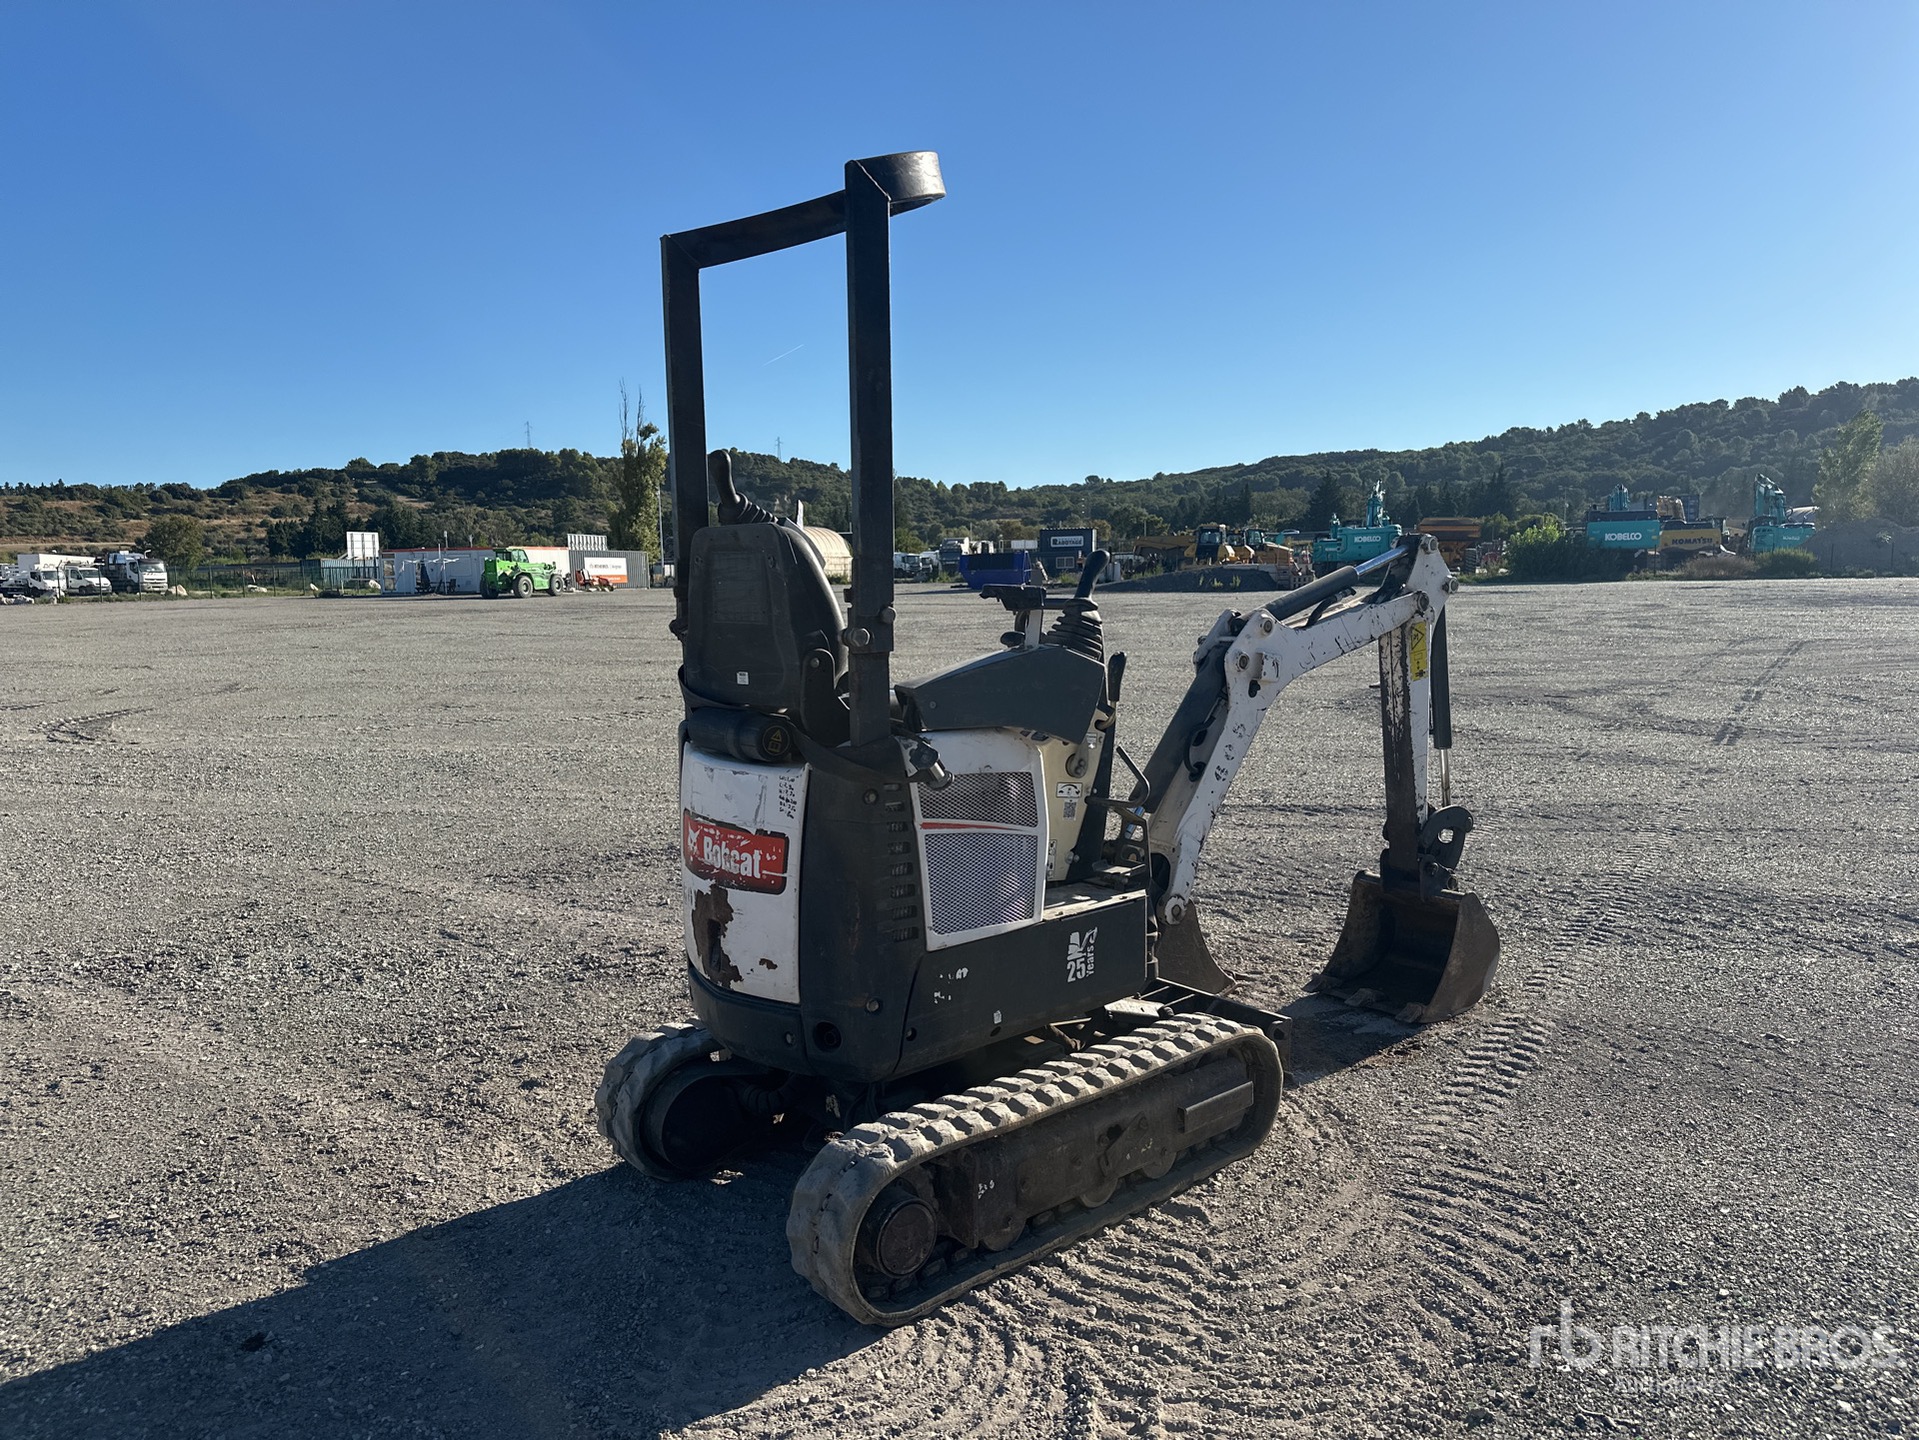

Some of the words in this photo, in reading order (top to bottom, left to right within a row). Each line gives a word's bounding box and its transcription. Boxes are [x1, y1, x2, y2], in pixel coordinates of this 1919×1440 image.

[1605, 532, 1642, 541] KOBELCO
[1672, 537, 1713, 545] KOMATSU
[703, 836, 761, 879] Bobcat
[1066, 957, 1086, 982] 25
[1086, 945, 1095, 977] Years
